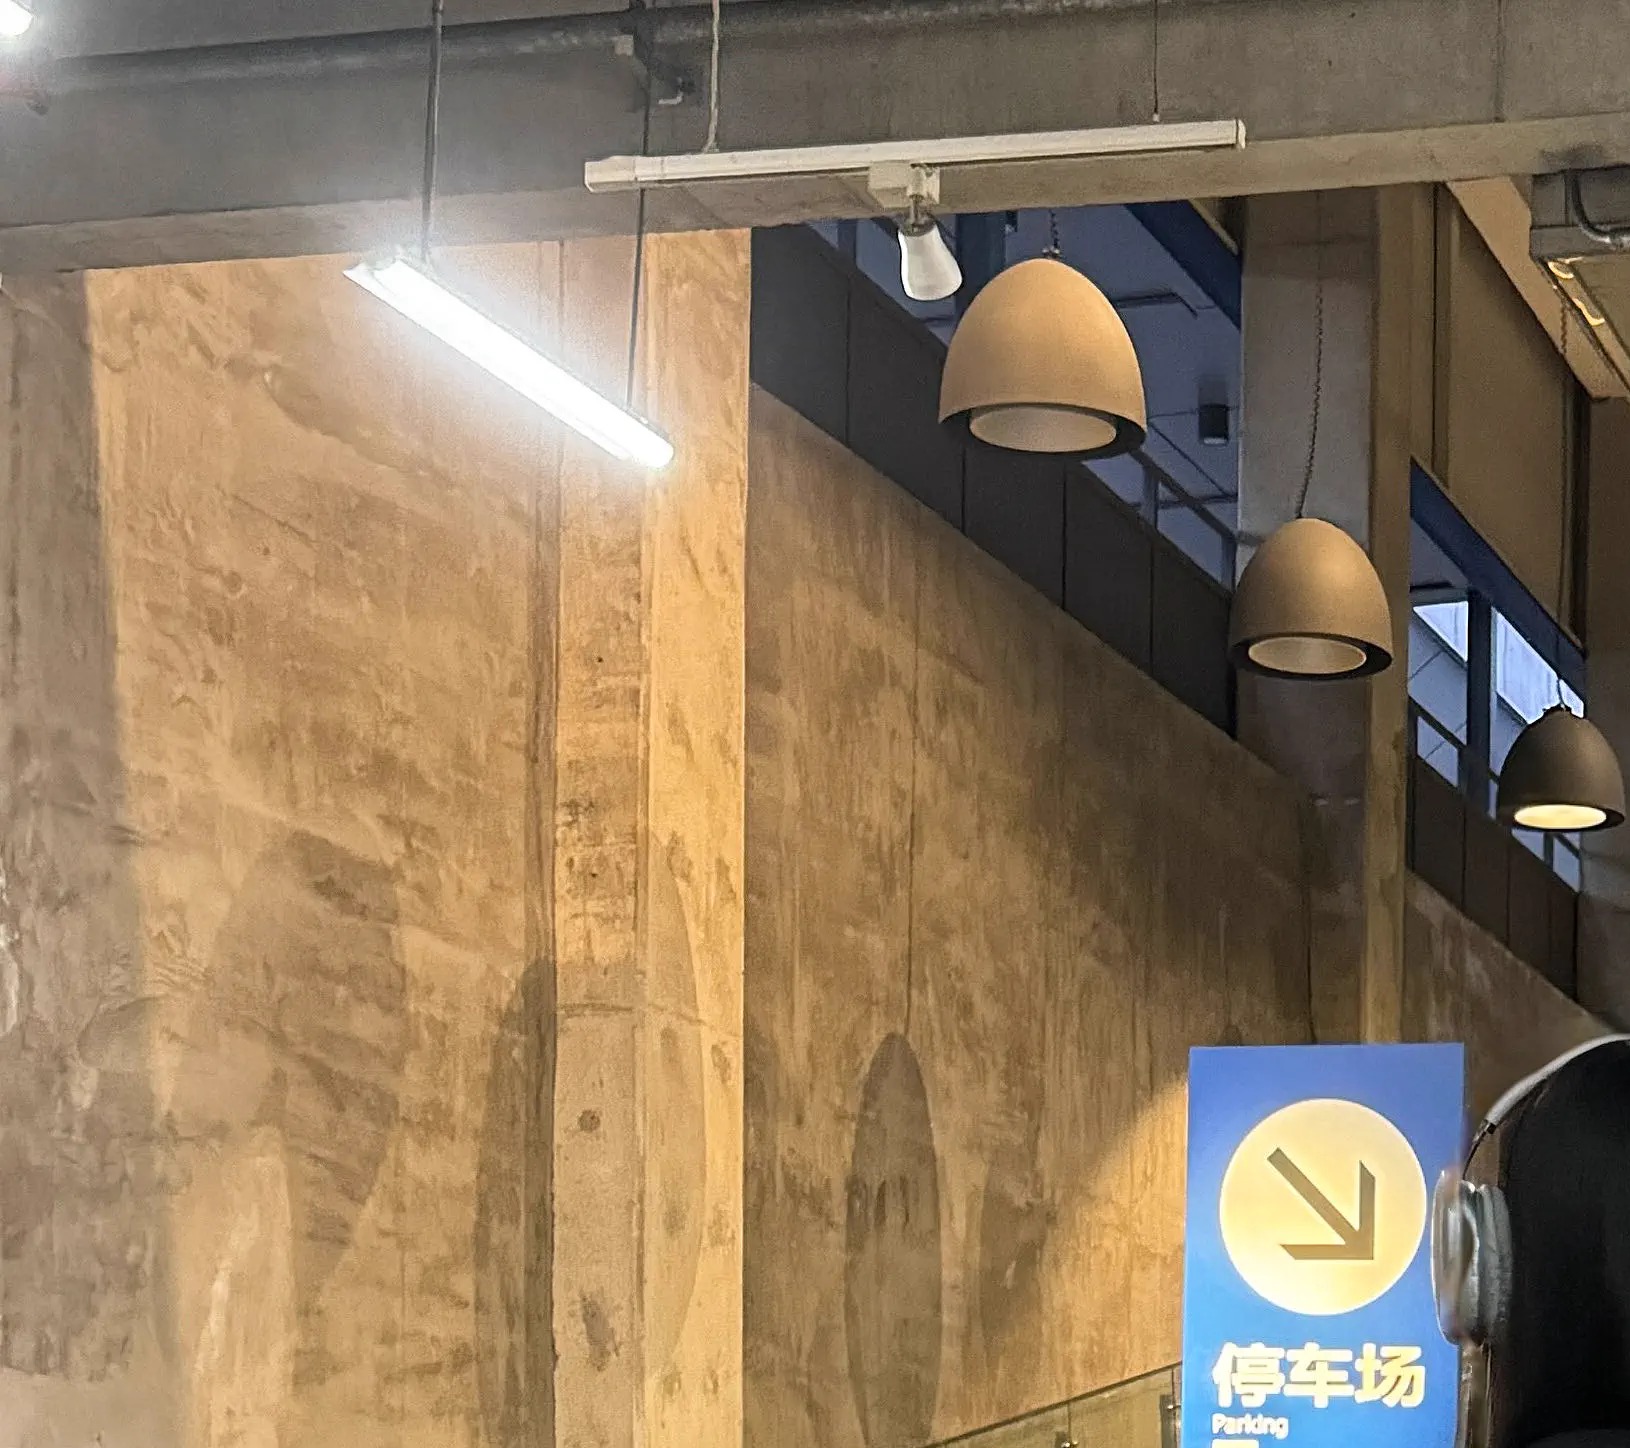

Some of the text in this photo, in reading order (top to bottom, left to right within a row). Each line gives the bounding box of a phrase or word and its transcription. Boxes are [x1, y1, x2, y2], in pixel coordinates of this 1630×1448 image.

[1212, 1341, 1426, 1409] 停车场
[1211, 1413, 1289, 1439] Parking
